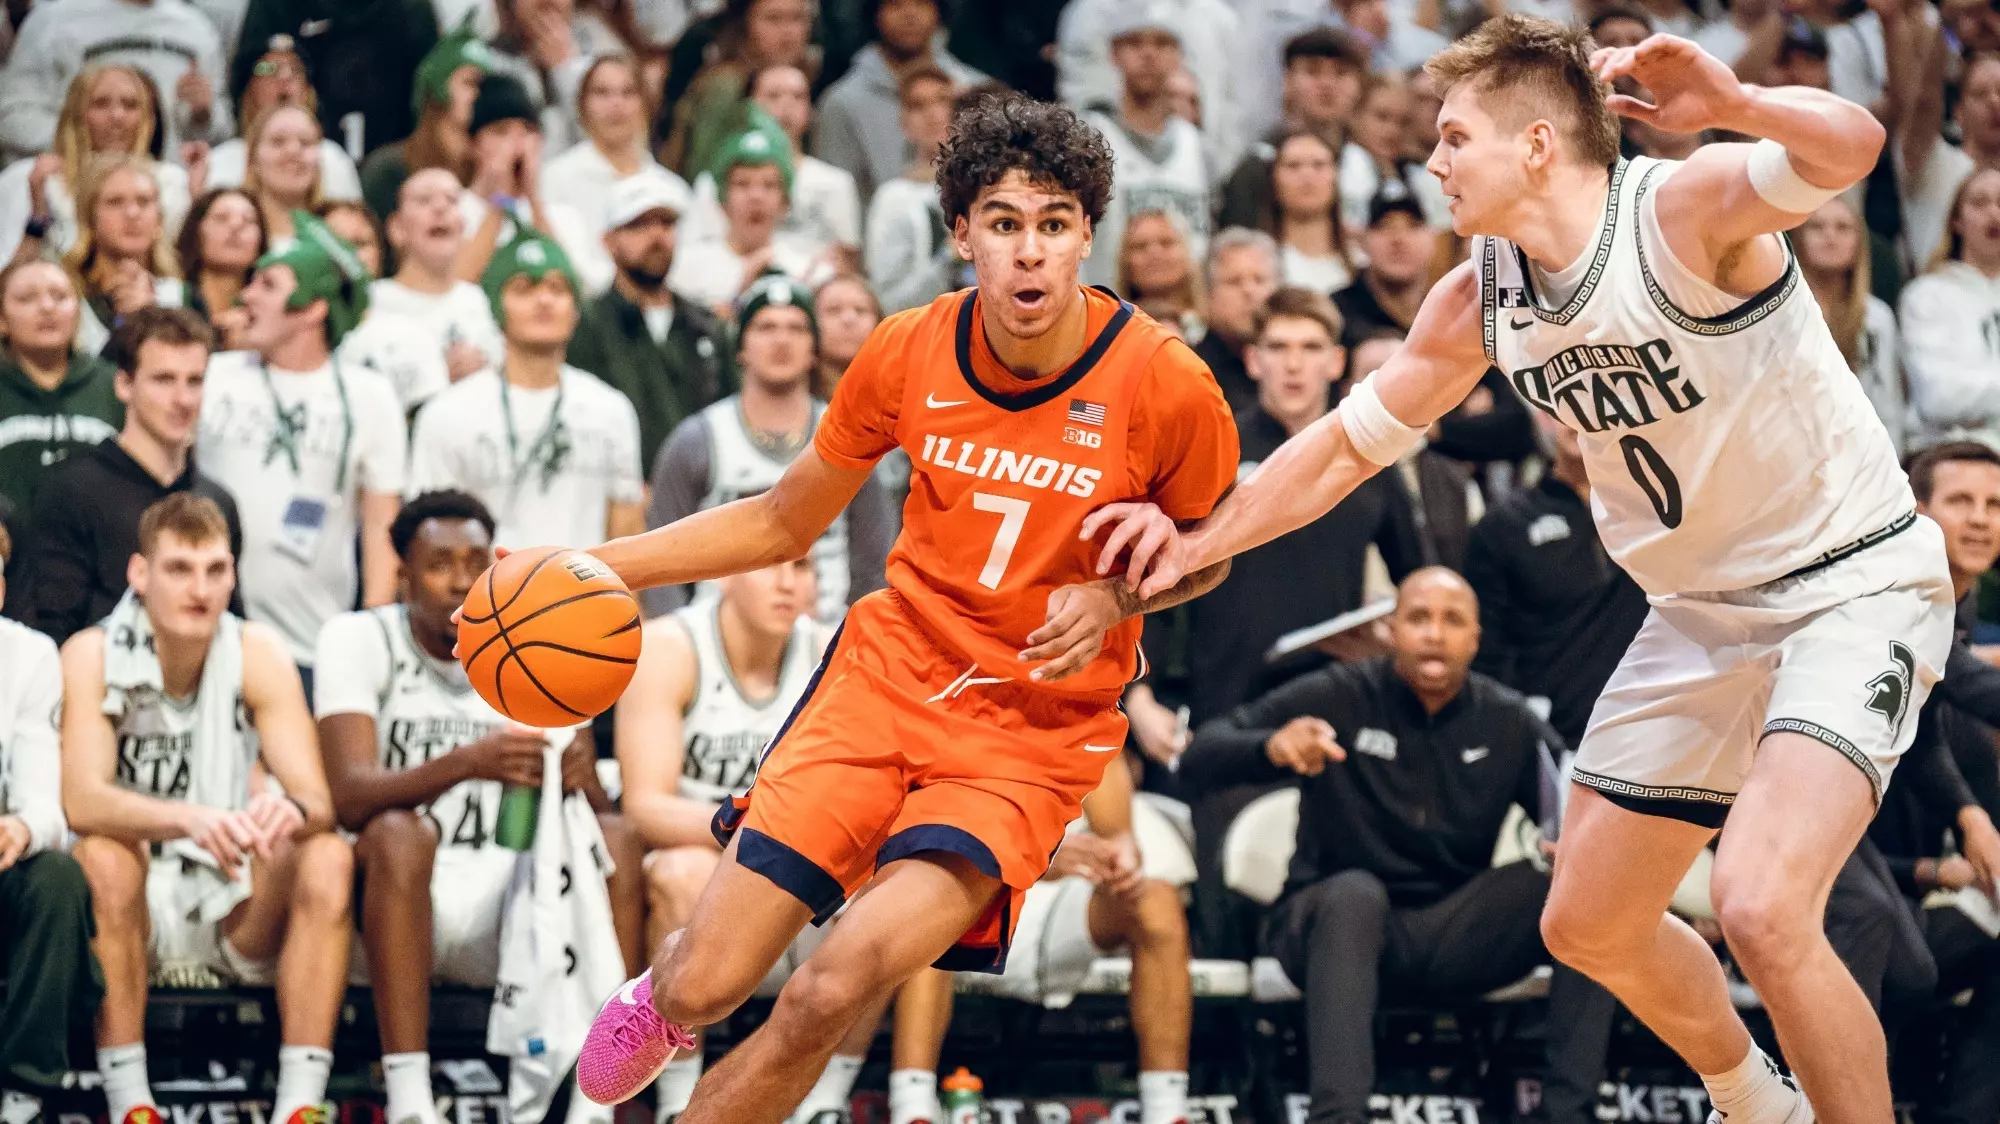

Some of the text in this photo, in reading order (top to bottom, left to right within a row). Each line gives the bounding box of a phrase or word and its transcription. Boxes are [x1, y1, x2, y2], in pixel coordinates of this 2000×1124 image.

[1503, 288, 1523, 308] JF
[1513, 338, 1707, 433] STATE
[1544, 346, 1642, 388] MICHIGAN
[921, 433, 1103, 498] ILLINOIS
[1619, 434, 1683, 530] 0
[973, 492, 1032, 591] 7
